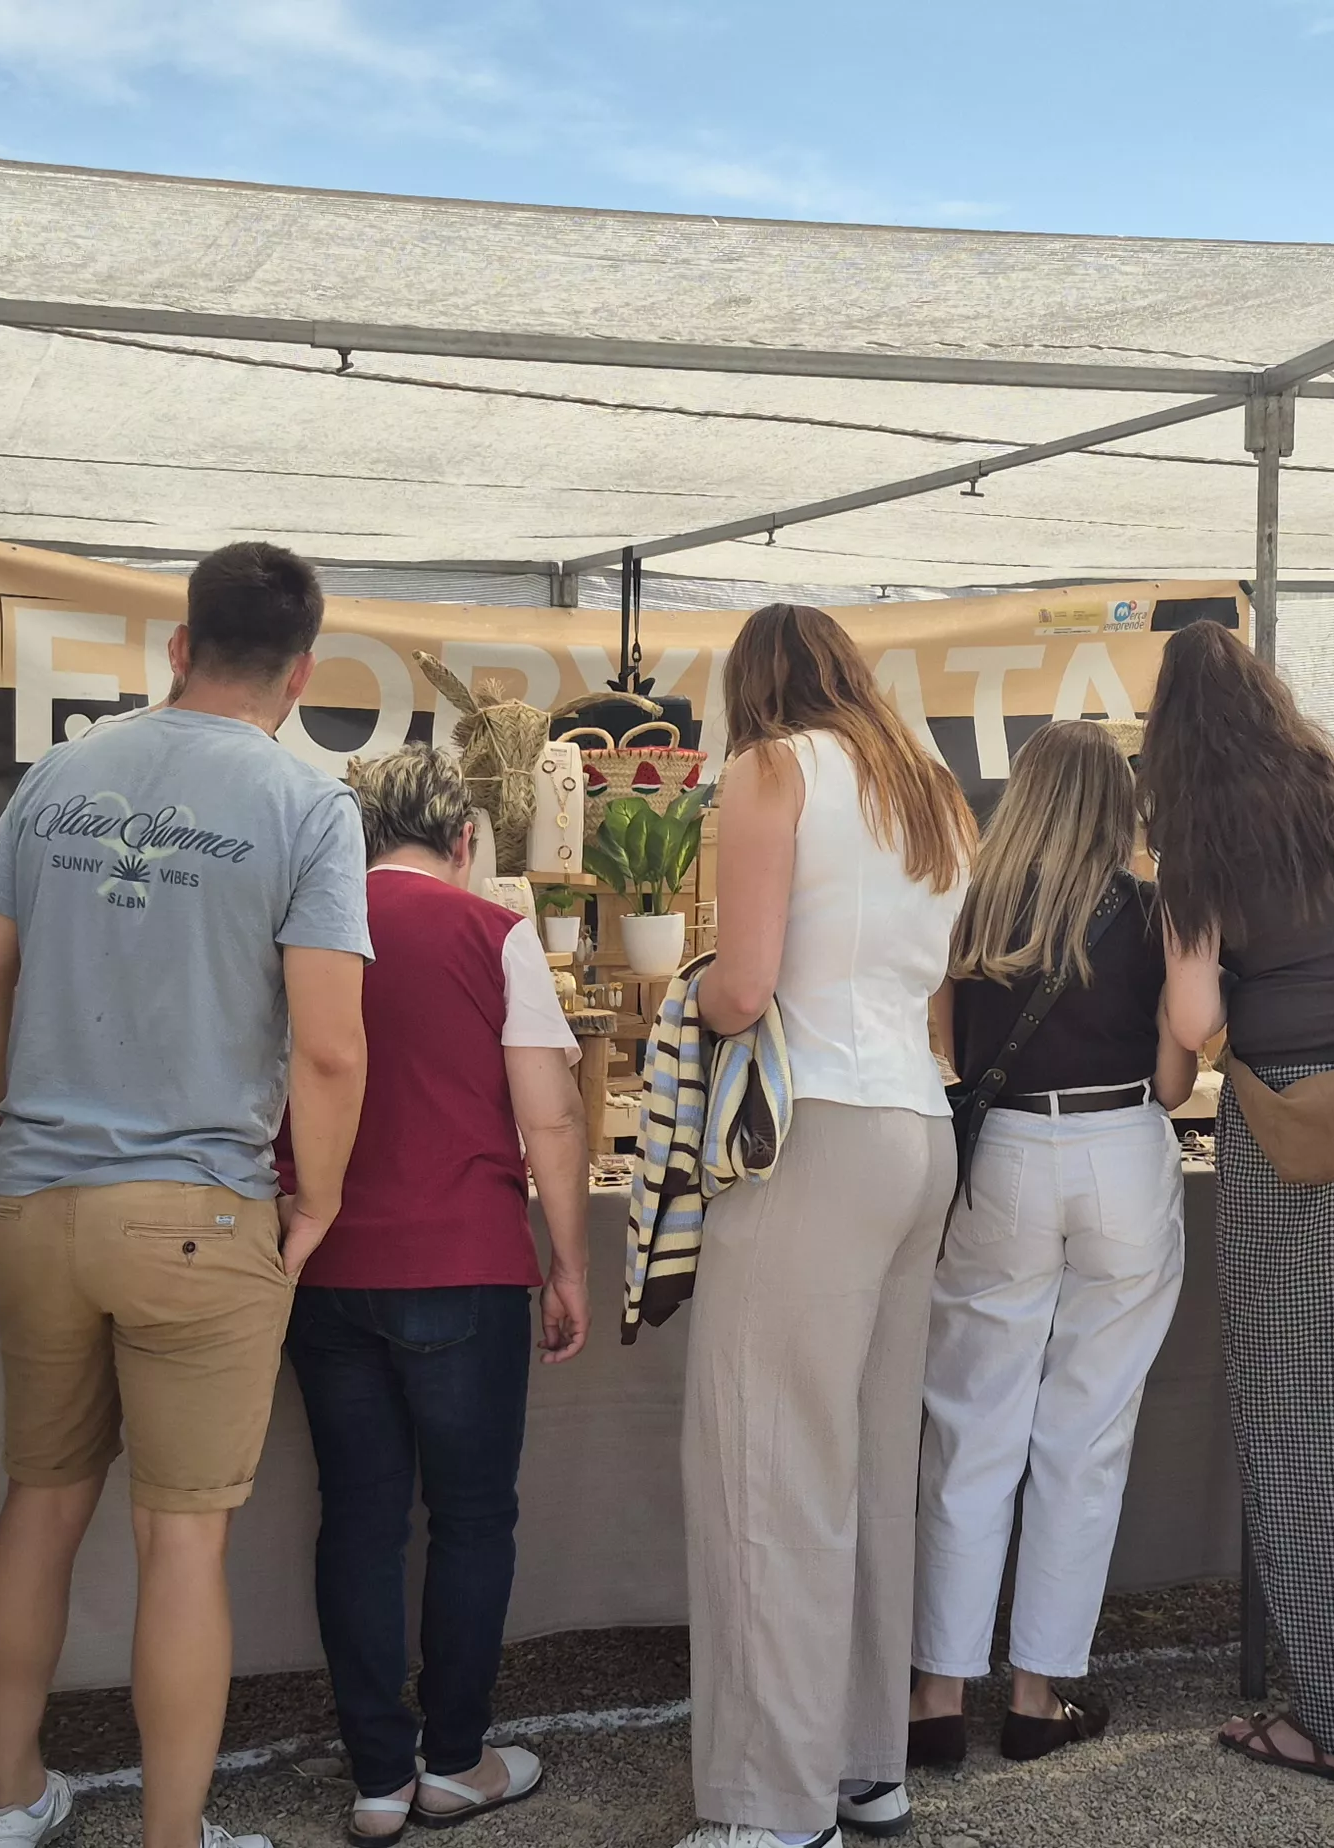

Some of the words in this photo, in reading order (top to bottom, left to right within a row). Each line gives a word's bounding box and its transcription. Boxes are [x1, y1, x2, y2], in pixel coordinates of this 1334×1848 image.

[1103, 620, 1145, 632] emprende
[34, 795, 123, 841] Slow
[120, 806, 255, 863] Summer
[51, 855, 104, 873] SUNNY
[160, 868, 200, 888] VIBES
[107, 892, 146, 909] SLBN
